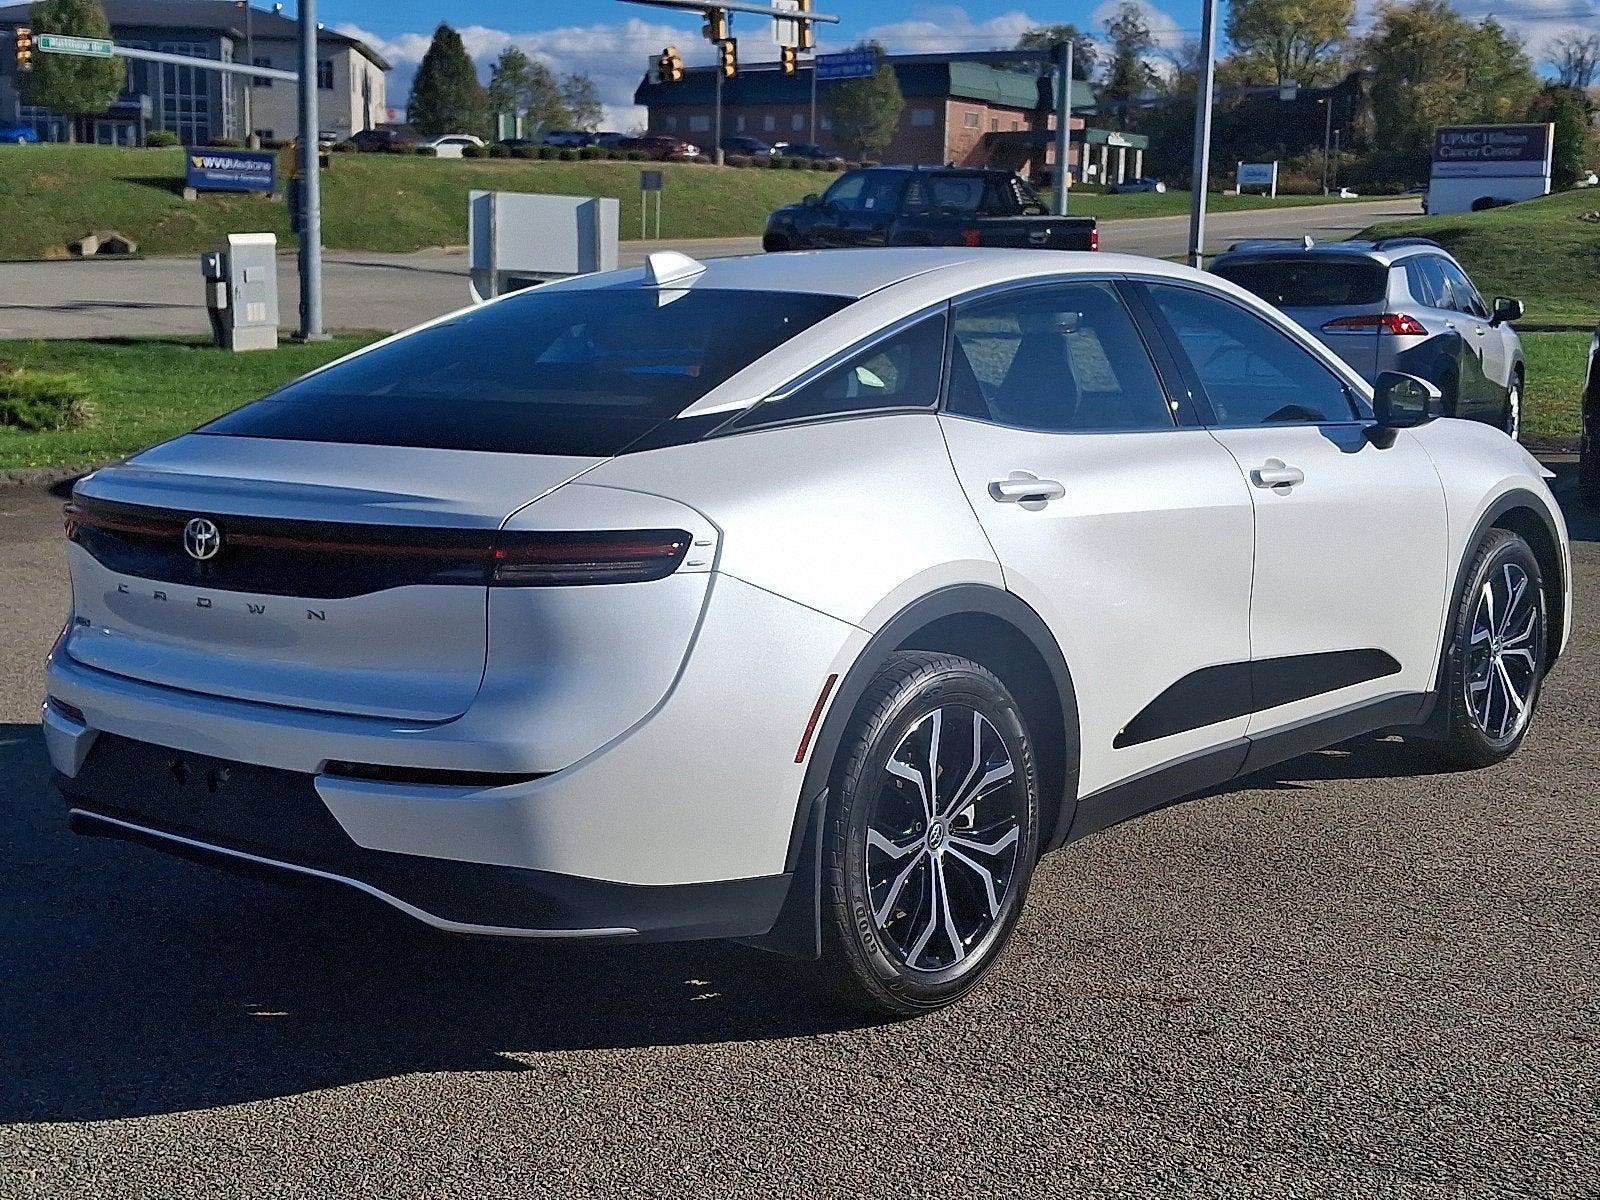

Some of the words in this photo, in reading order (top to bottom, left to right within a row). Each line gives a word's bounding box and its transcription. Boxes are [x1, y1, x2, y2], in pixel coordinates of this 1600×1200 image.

[1440, 132, 1481, 145] UPMC
[1483, 144, 1521, 157] Center
[117, 584, 325, 620] CROWN
